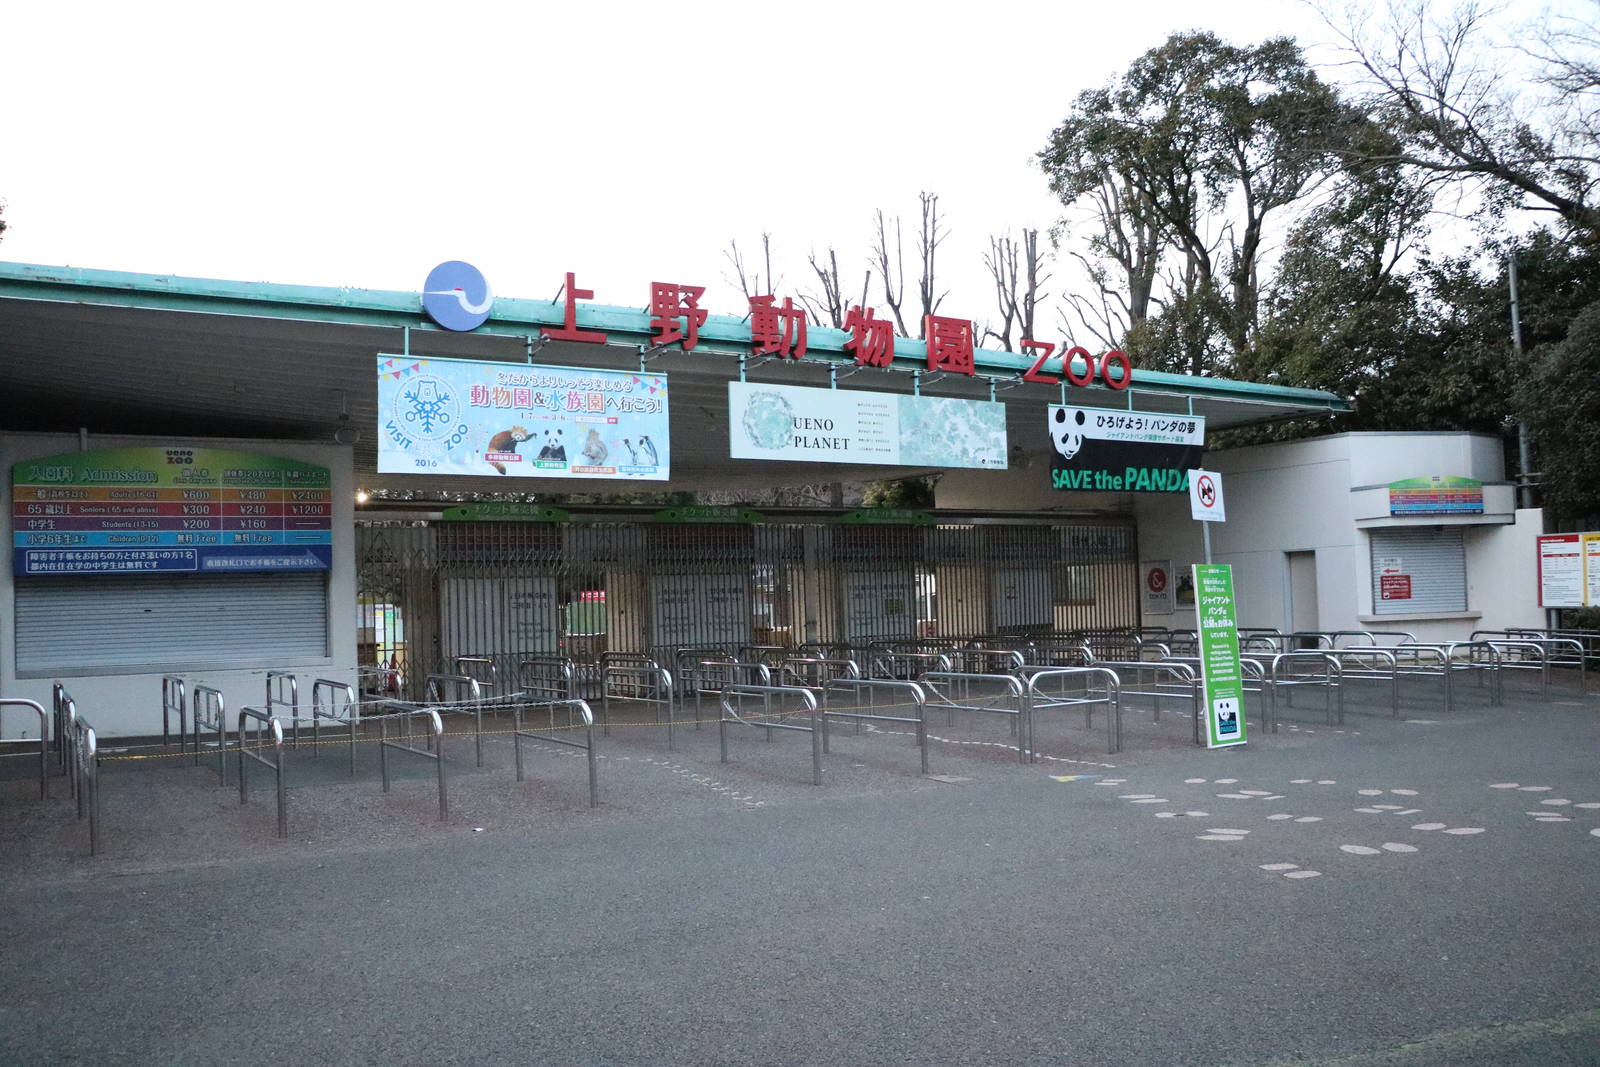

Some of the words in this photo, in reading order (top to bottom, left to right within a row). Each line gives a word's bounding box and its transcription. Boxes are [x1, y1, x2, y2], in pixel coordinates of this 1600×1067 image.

[540, 272, 974, 377] 上野動物園
[1020, 339, 1132, 391] ZOO
[793, 417, 834, 432] UENO
[385, 420, 412, 449] VISIT
[443, 424, 468, 451] ZOO
[794, 435, 851, 450] PLANET
[415, 459, 438, 467] 2016
[80, 468, 159, 483] Admission
[1052, 468, 1092, 489] SAVE
[1095, 469, 1122, 490] the
[27, 504, 41, 514] 65
[183, 505, 209, 514] ¥300
[240, 505, 266, 514] ¥240
[292, 505, 323, 514] ¥1200
[27, 519, 56, 530] 中学生
[183, 519, 210, 528] ¥200
[240, 519, 266, 528] ¥160
[177, 534, 193, 542] 無料
[196, 534, 216, 543] Free
[234, 534, 250, 542] 無料
[253, 534, 272, 542] Free
